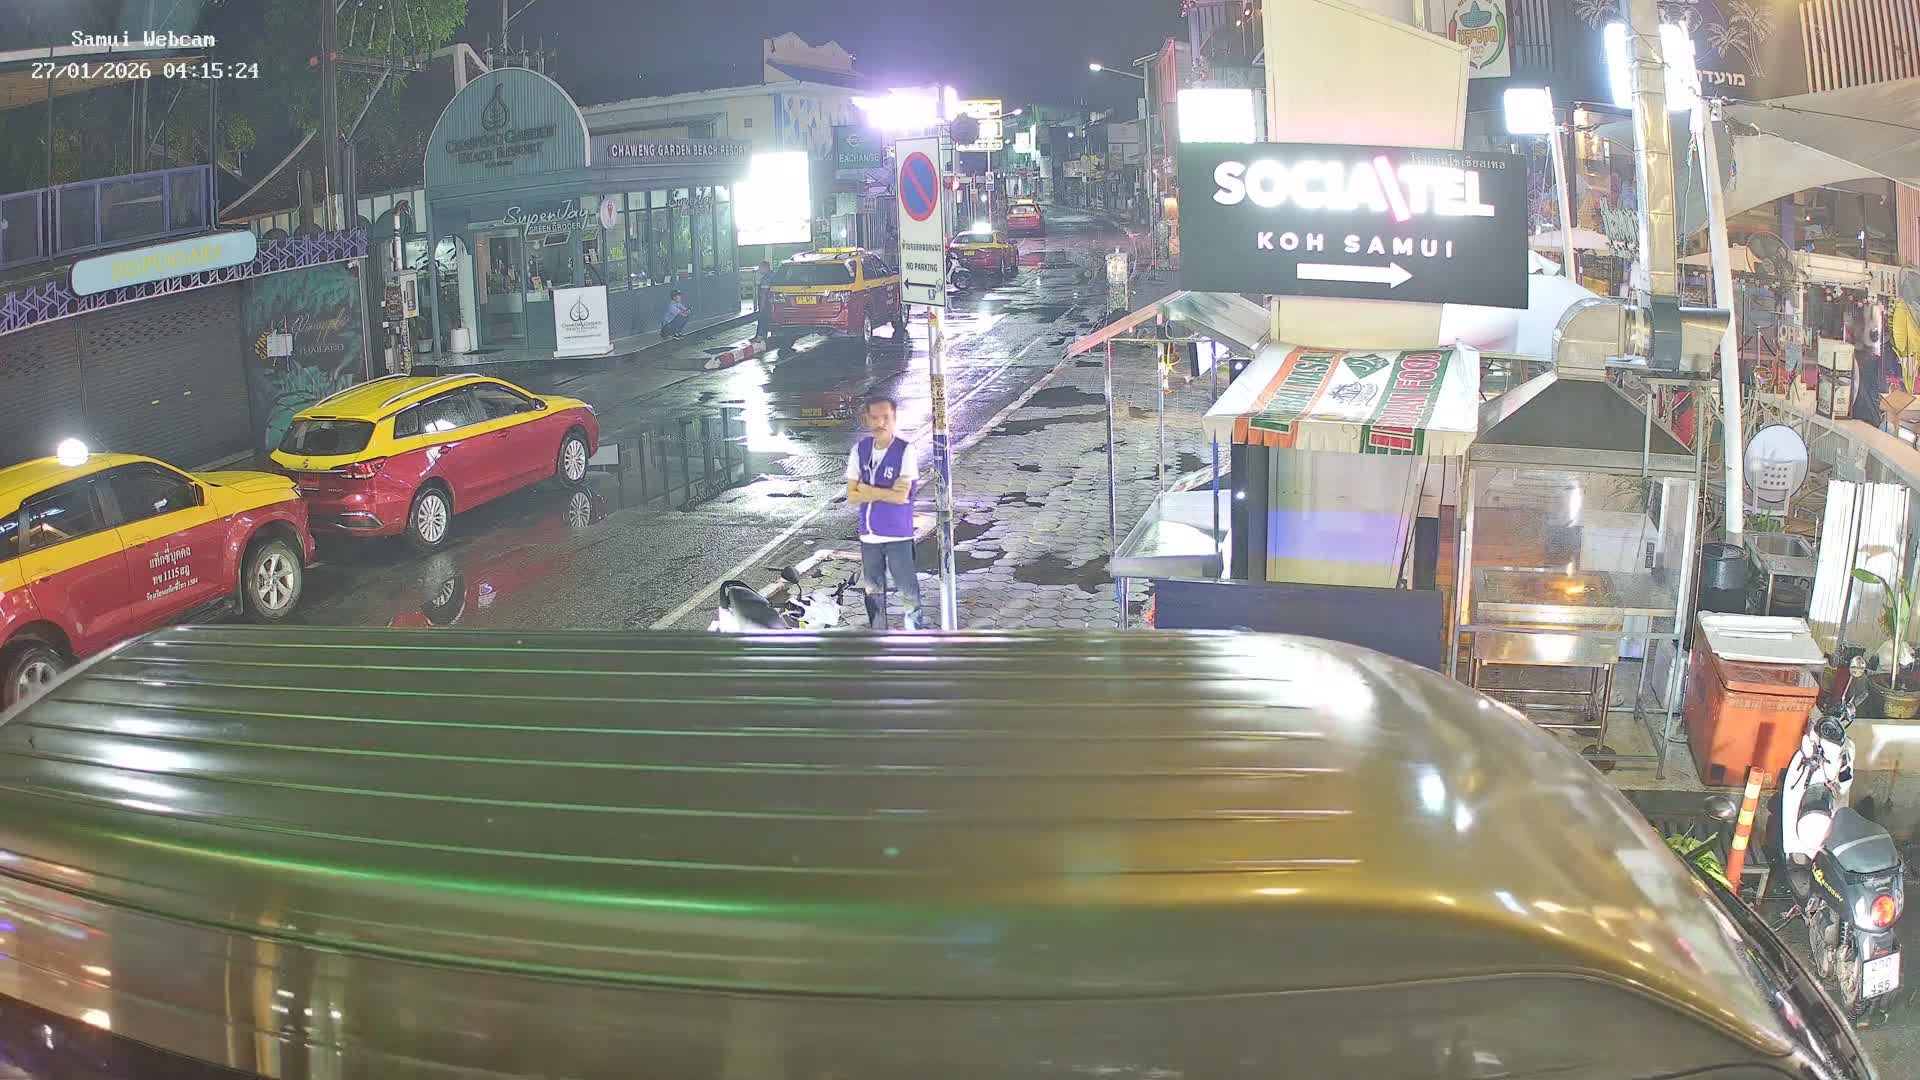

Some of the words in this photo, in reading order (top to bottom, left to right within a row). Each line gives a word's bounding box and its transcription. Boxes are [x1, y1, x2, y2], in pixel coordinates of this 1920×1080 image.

[611, 143, 655, 157] CHAWENG
[658, 144, 691, 156] GARDEN
[693, 144, 718, 156] BEACH
[839, 152, 880, 162] EXCHANGE
[1257, 231, 1325, 251] KOH
[1343, 234, 1454, 258] SAMUI
[111, 243, 224, 281] DISPENSARY
[906, 262, 913, 270] NO
[915, 263, 938, 272] PARKING
[164, 567, 179, 581] 1115
